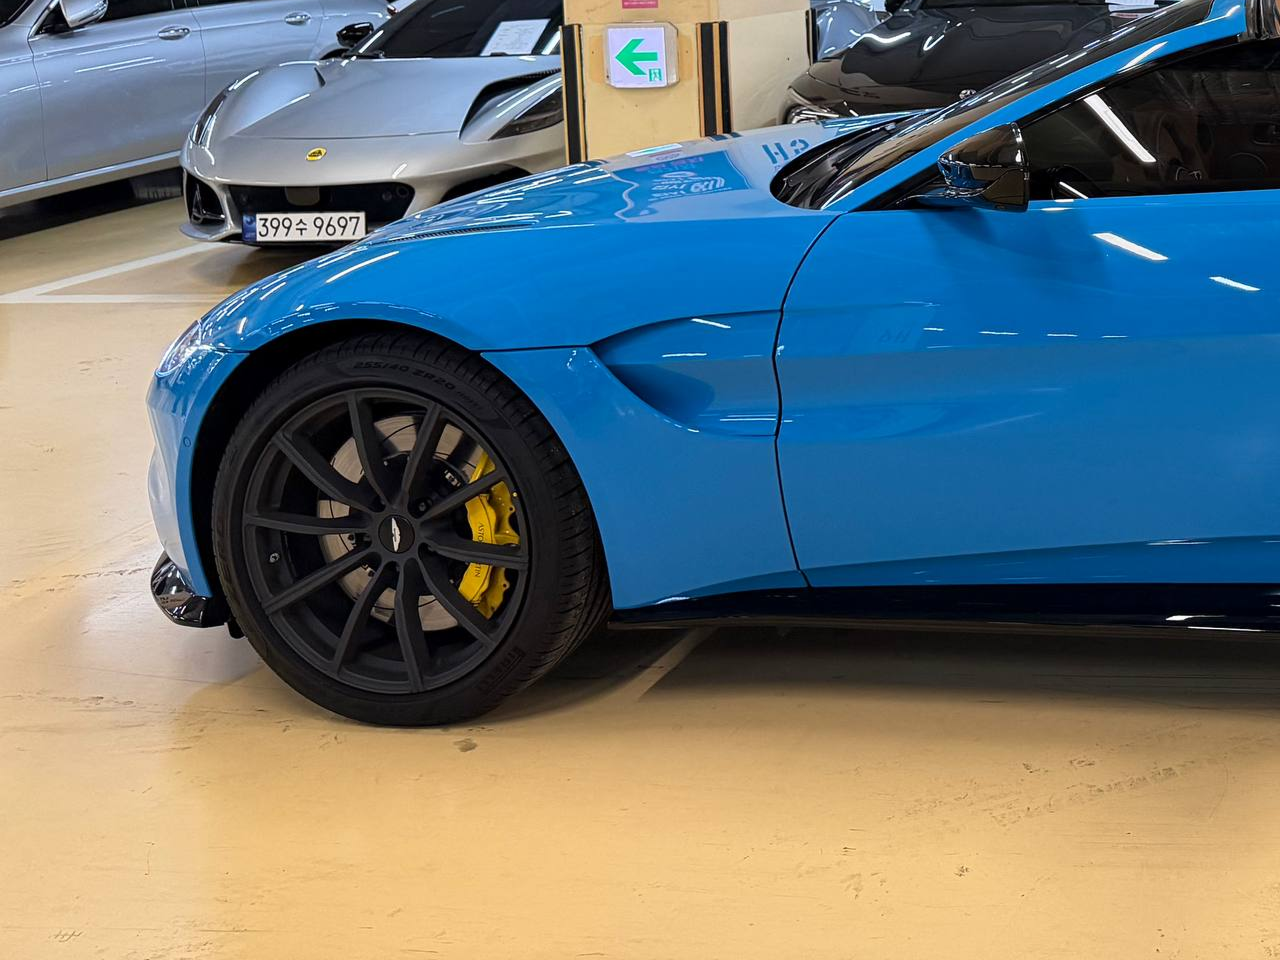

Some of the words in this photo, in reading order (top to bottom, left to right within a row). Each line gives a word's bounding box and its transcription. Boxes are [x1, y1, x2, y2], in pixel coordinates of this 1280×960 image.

[258, 218, 308, 238] 399수
[313, 216, 361, 237] 9697
[353, 361, 409, 373] 255/40
